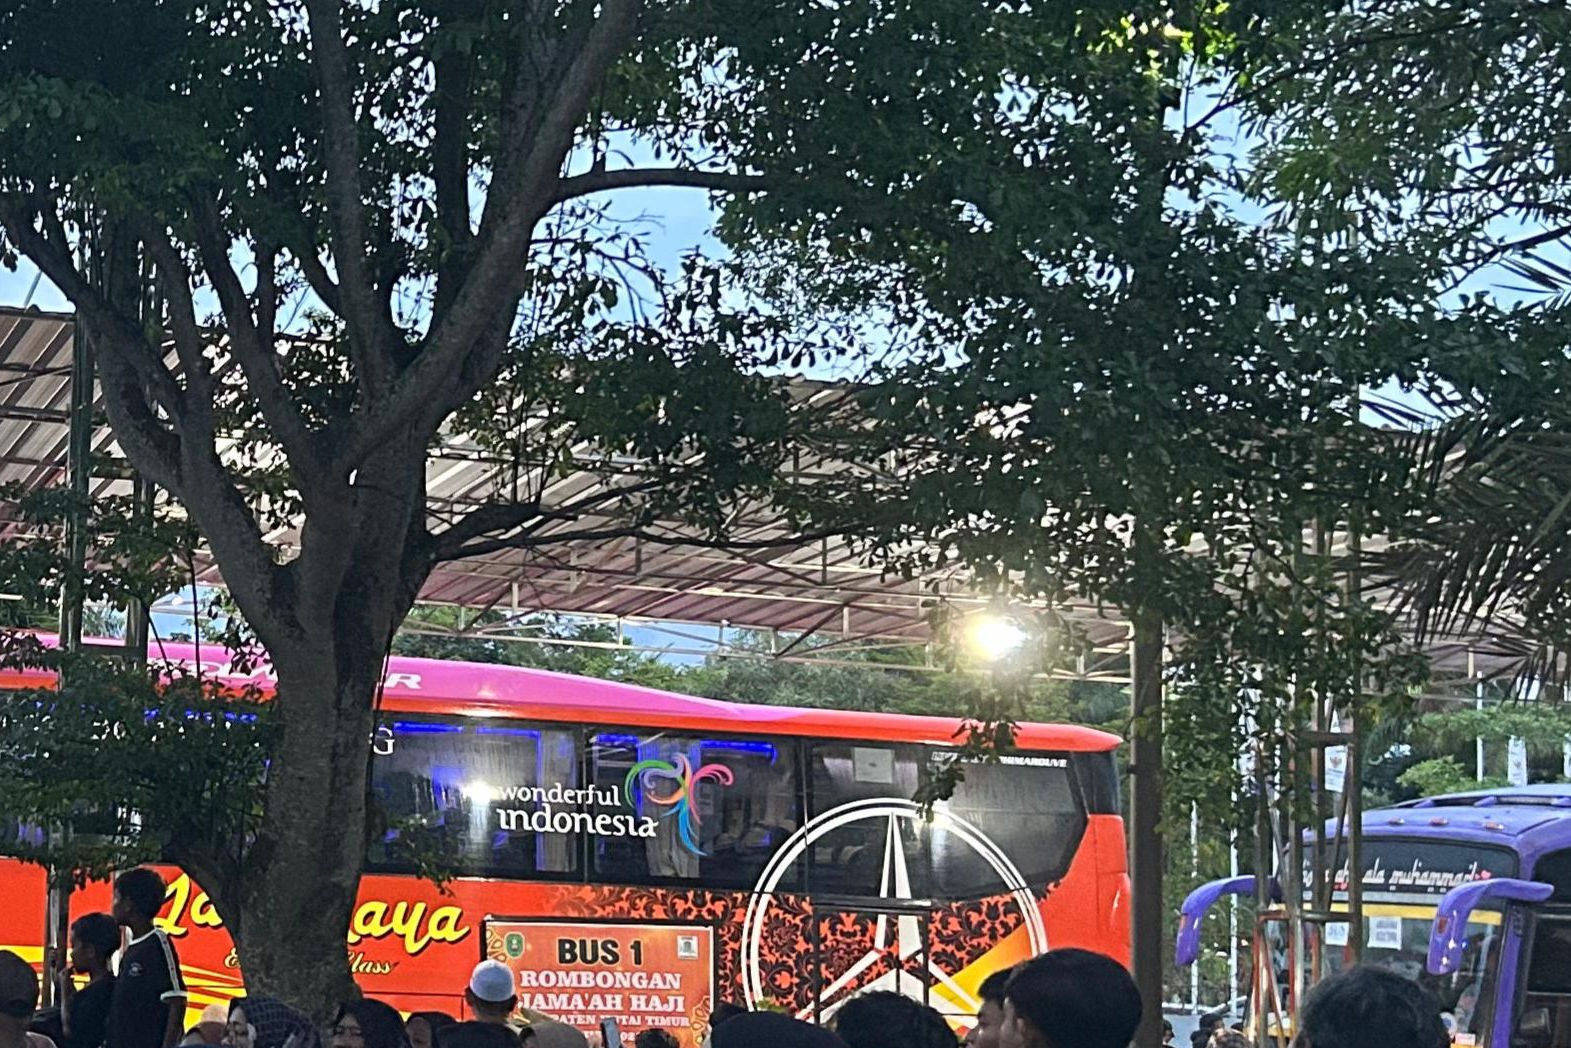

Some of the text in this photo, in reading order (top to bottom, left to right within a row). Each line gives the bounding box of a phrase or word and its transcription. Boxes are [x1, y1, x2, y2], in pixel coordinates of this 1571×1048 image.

[499, 783, 622, 806] wonderful
[496, 803, 659, 837] indonesia
[557, 938, 643, 966] BUS 1
[520, 970, 682, 990] ROMBONGAN
[517, 993, 685, 1013] JAMA'AH HAJI
[645, 1016, 690, 1027] TIMUR
